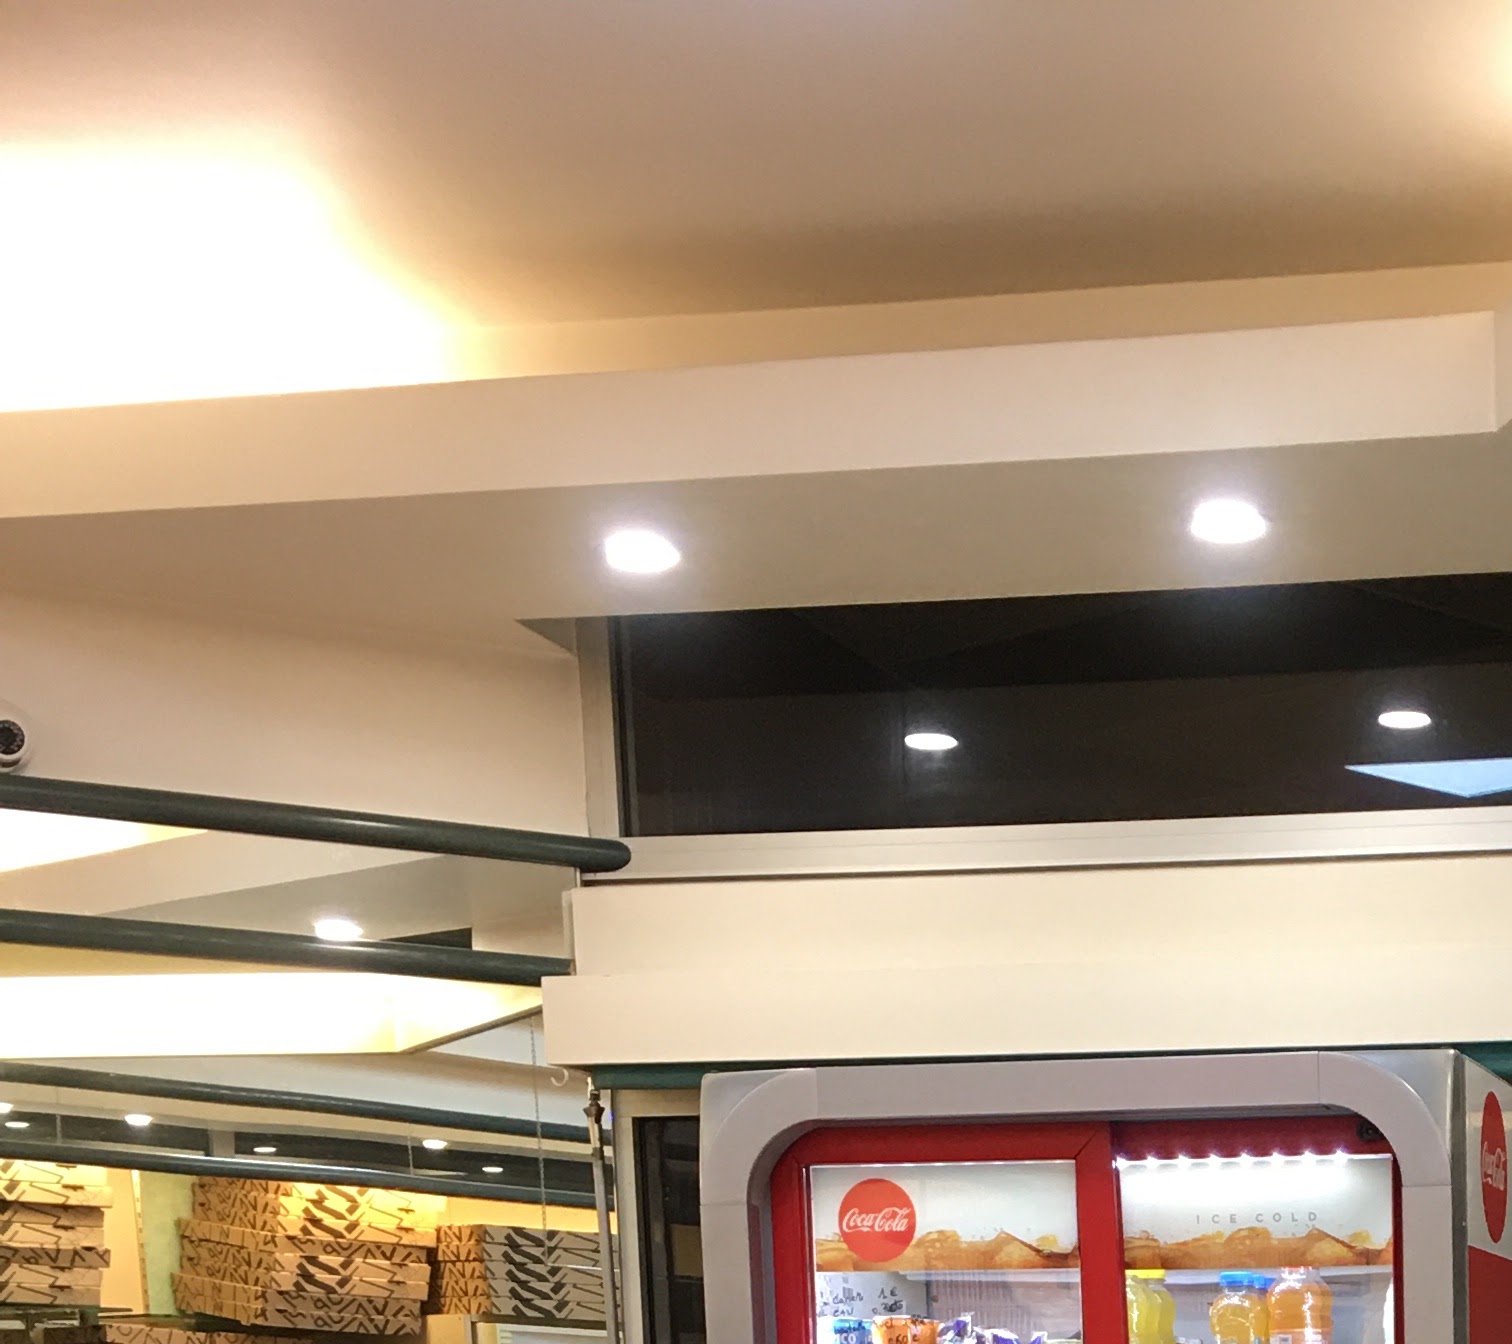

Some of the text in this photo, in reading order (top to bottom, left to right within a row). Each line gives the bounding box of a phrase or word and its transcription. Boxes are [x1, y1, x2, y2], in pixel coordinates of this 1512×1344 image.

[842, 1207, 912, 1232] Coca-Cola
[1197, 1211, 1317, 1225] ICE COLD
